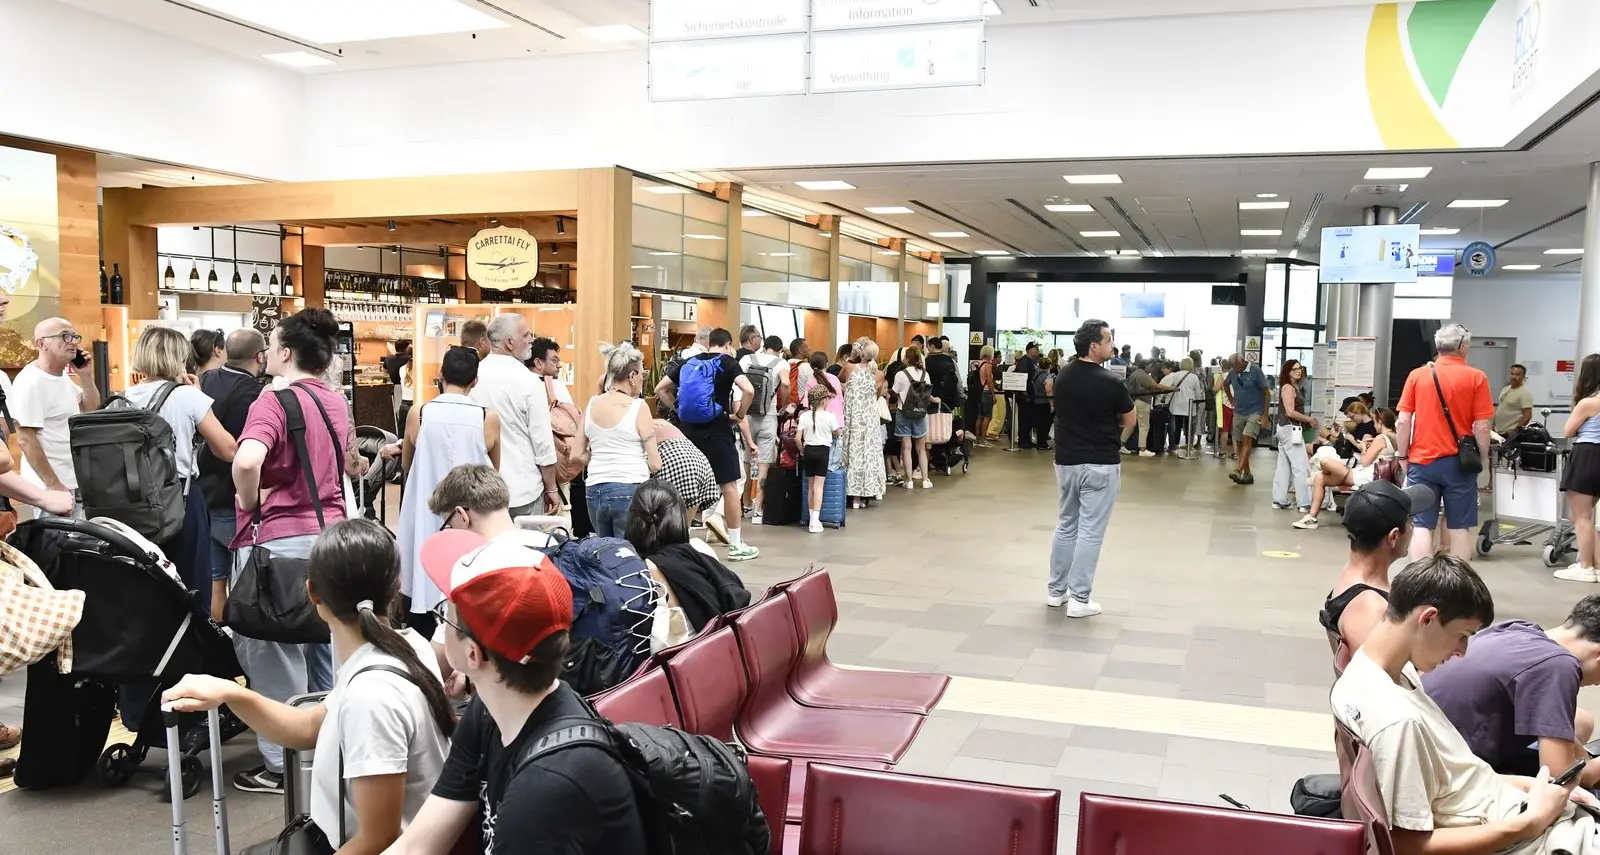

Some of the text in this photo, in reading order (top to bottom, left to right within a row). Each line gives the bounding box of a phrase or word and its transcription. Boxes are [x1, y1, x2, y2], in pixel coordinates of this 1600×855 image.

[848, 6, 913, 20] Information
[684, 15, 787, 32] Sicherheitskontrolle
[830, 70, 890, 83] Verwaltung
[475, 235, 531, 251] CARRETTAI FLY
